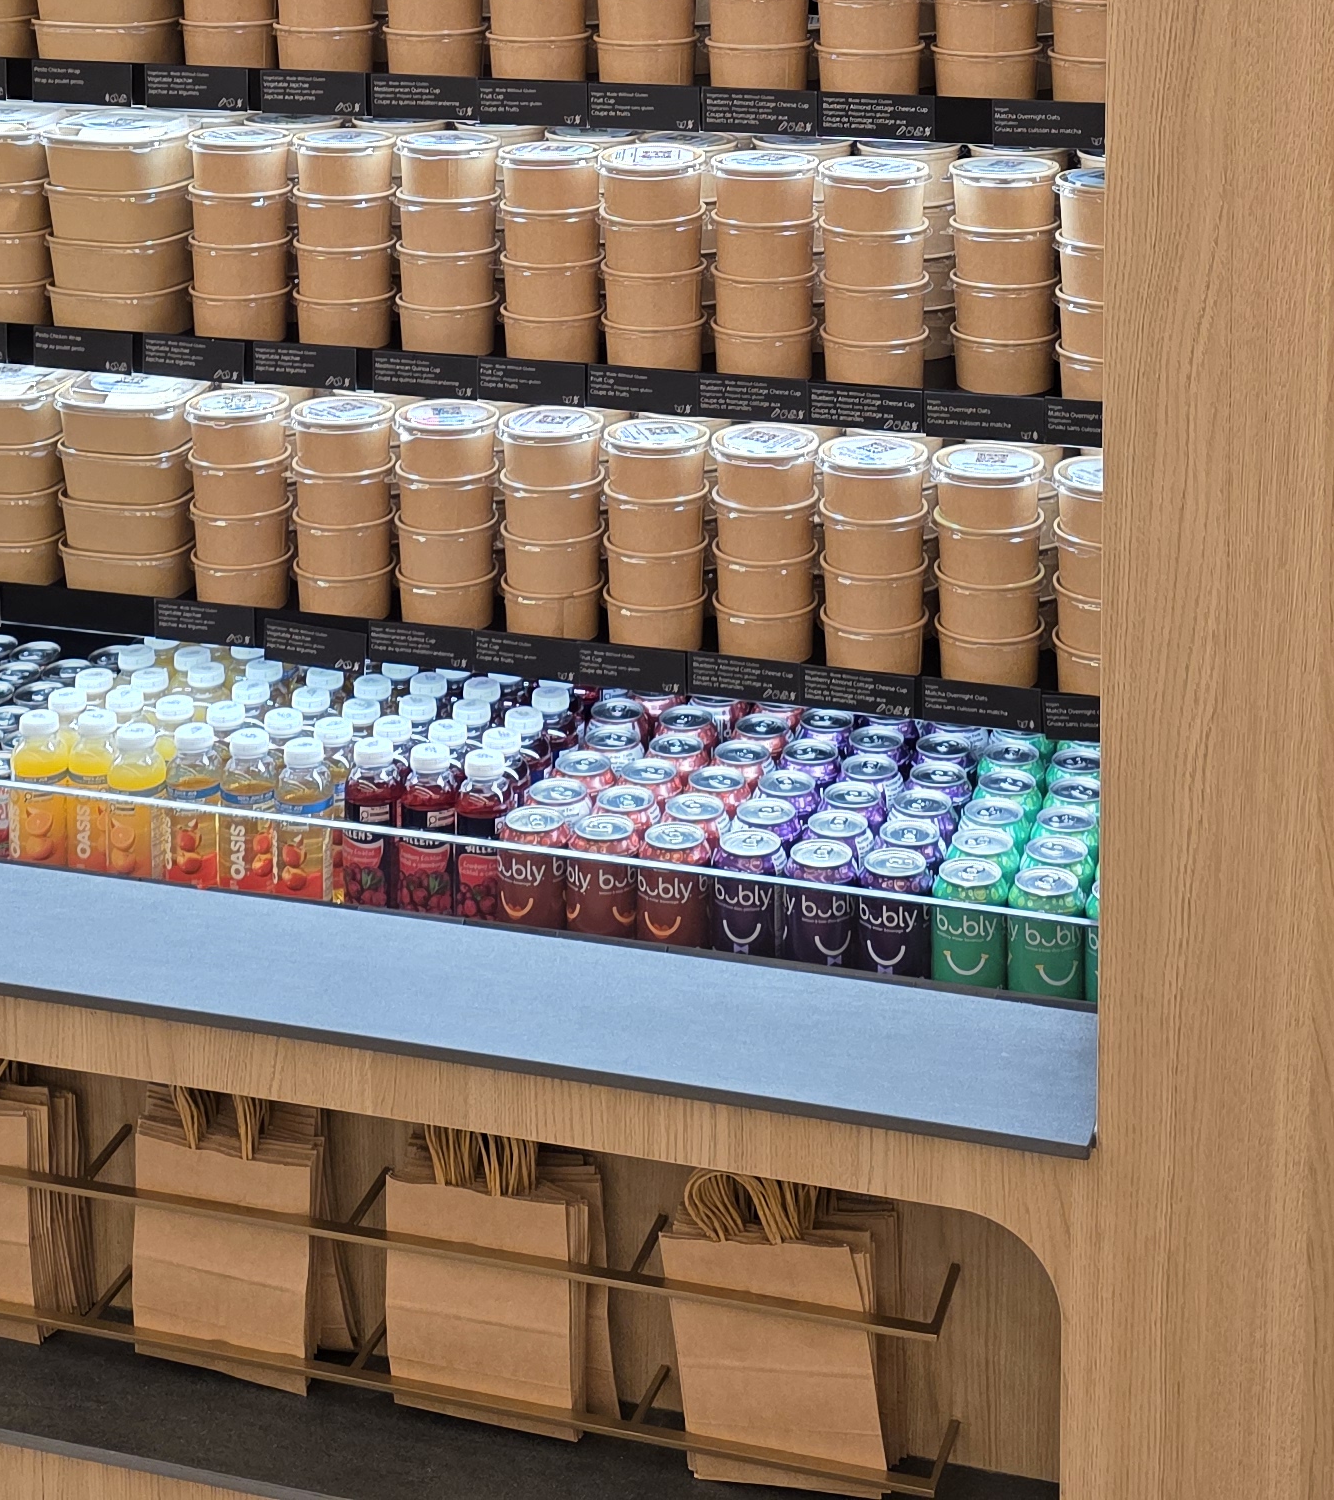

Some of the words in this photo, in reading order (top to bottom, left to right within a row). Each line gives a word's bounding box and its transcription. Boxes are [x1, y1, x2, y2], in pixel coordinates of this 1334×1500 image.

[77, 804, 90, 859] OASIS
[230, 824, 245, 880] OASIS
[638, 873, 692, 904] bubly
[715, 878, 772, 911] bubly
[860, 896, 917, 932] bubly
[937, 908, 997, 941] bubly
